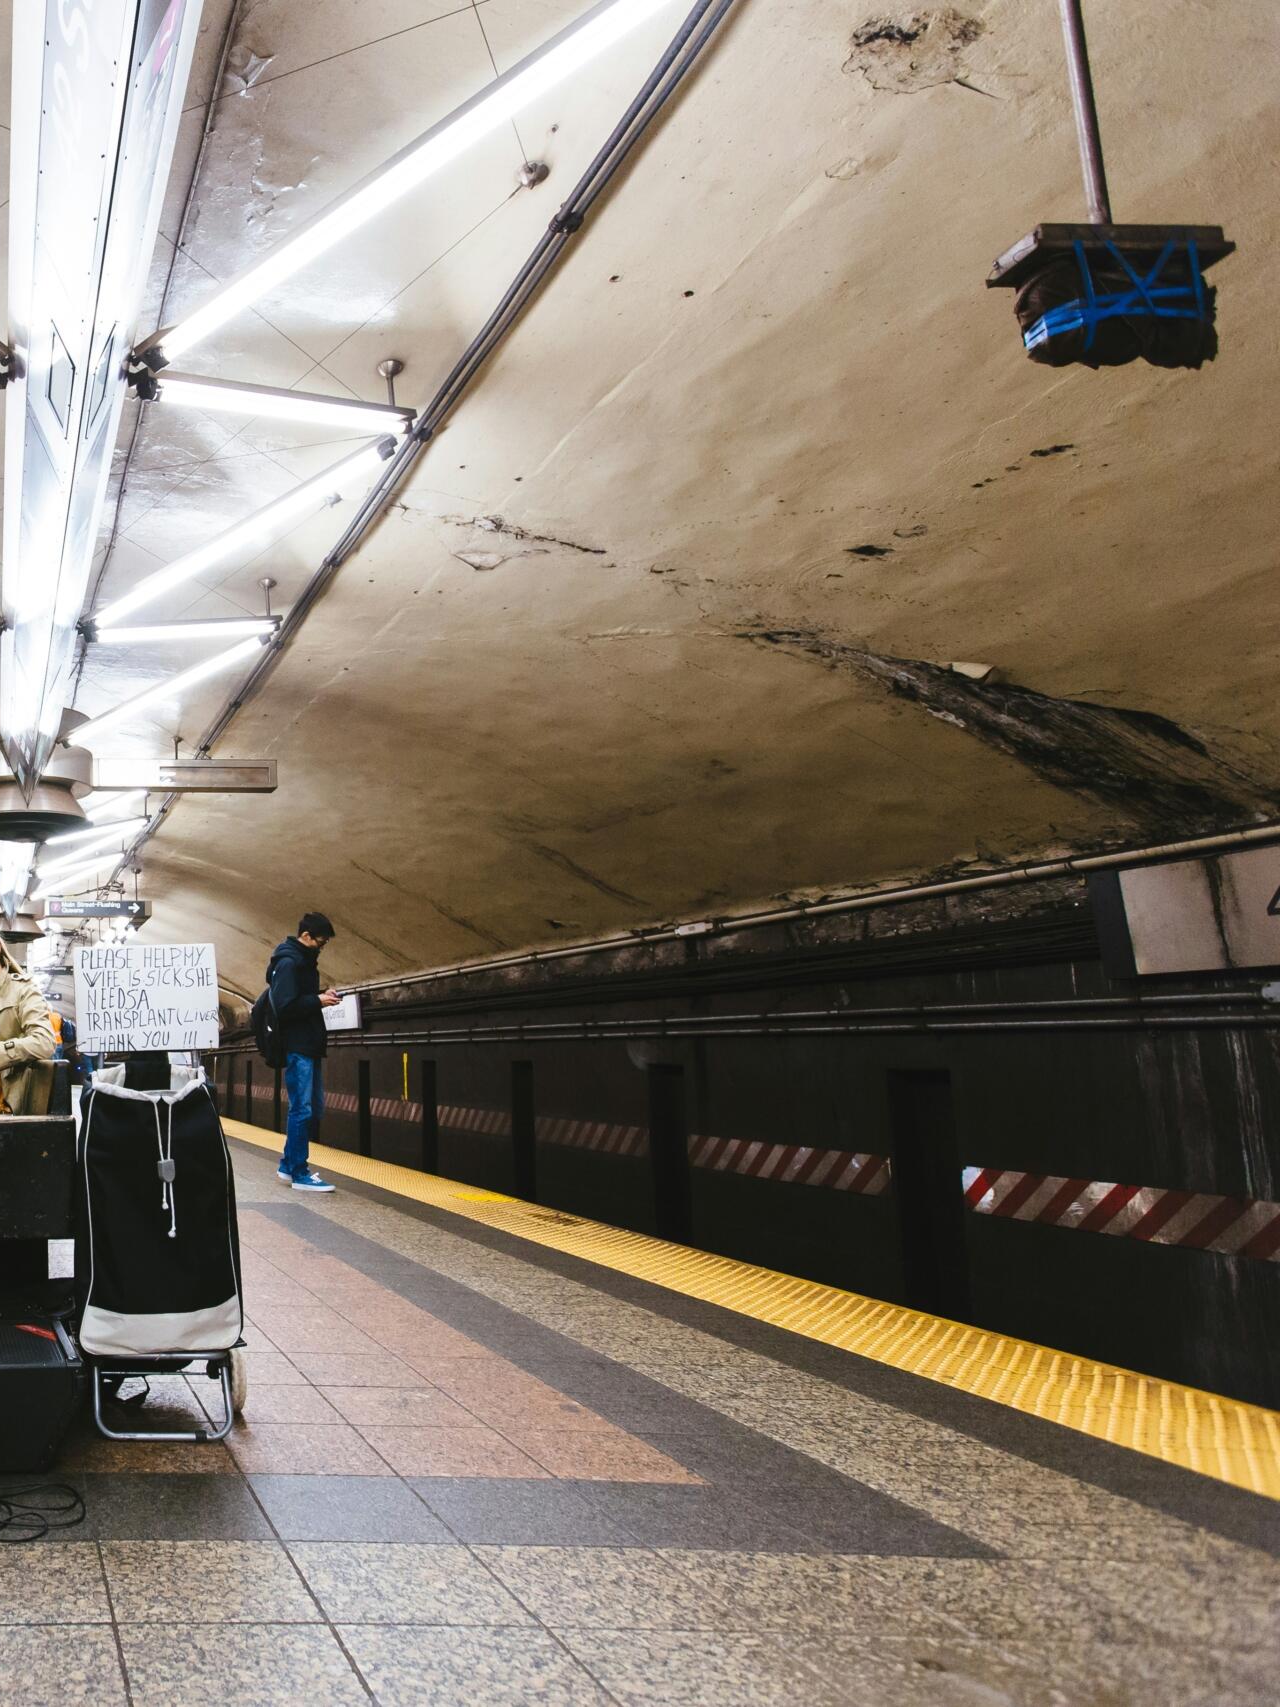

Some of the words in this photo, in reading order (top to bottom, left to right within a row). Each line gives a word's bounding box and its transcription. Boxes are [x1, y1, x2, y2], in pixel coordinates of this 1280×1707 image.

[81, 948, 134, 969] PLEASE
[184, 946, 206, 967] MY
[83, 968, 120, 987] WIFE
[128, 969, 141, 987] IS
[185, 967, 214, 987] SHE
[137, 989, 150, 1010] A
[87, 1033, 137, 1052] THANK
[142, 1030, 171, 1048] YOU
